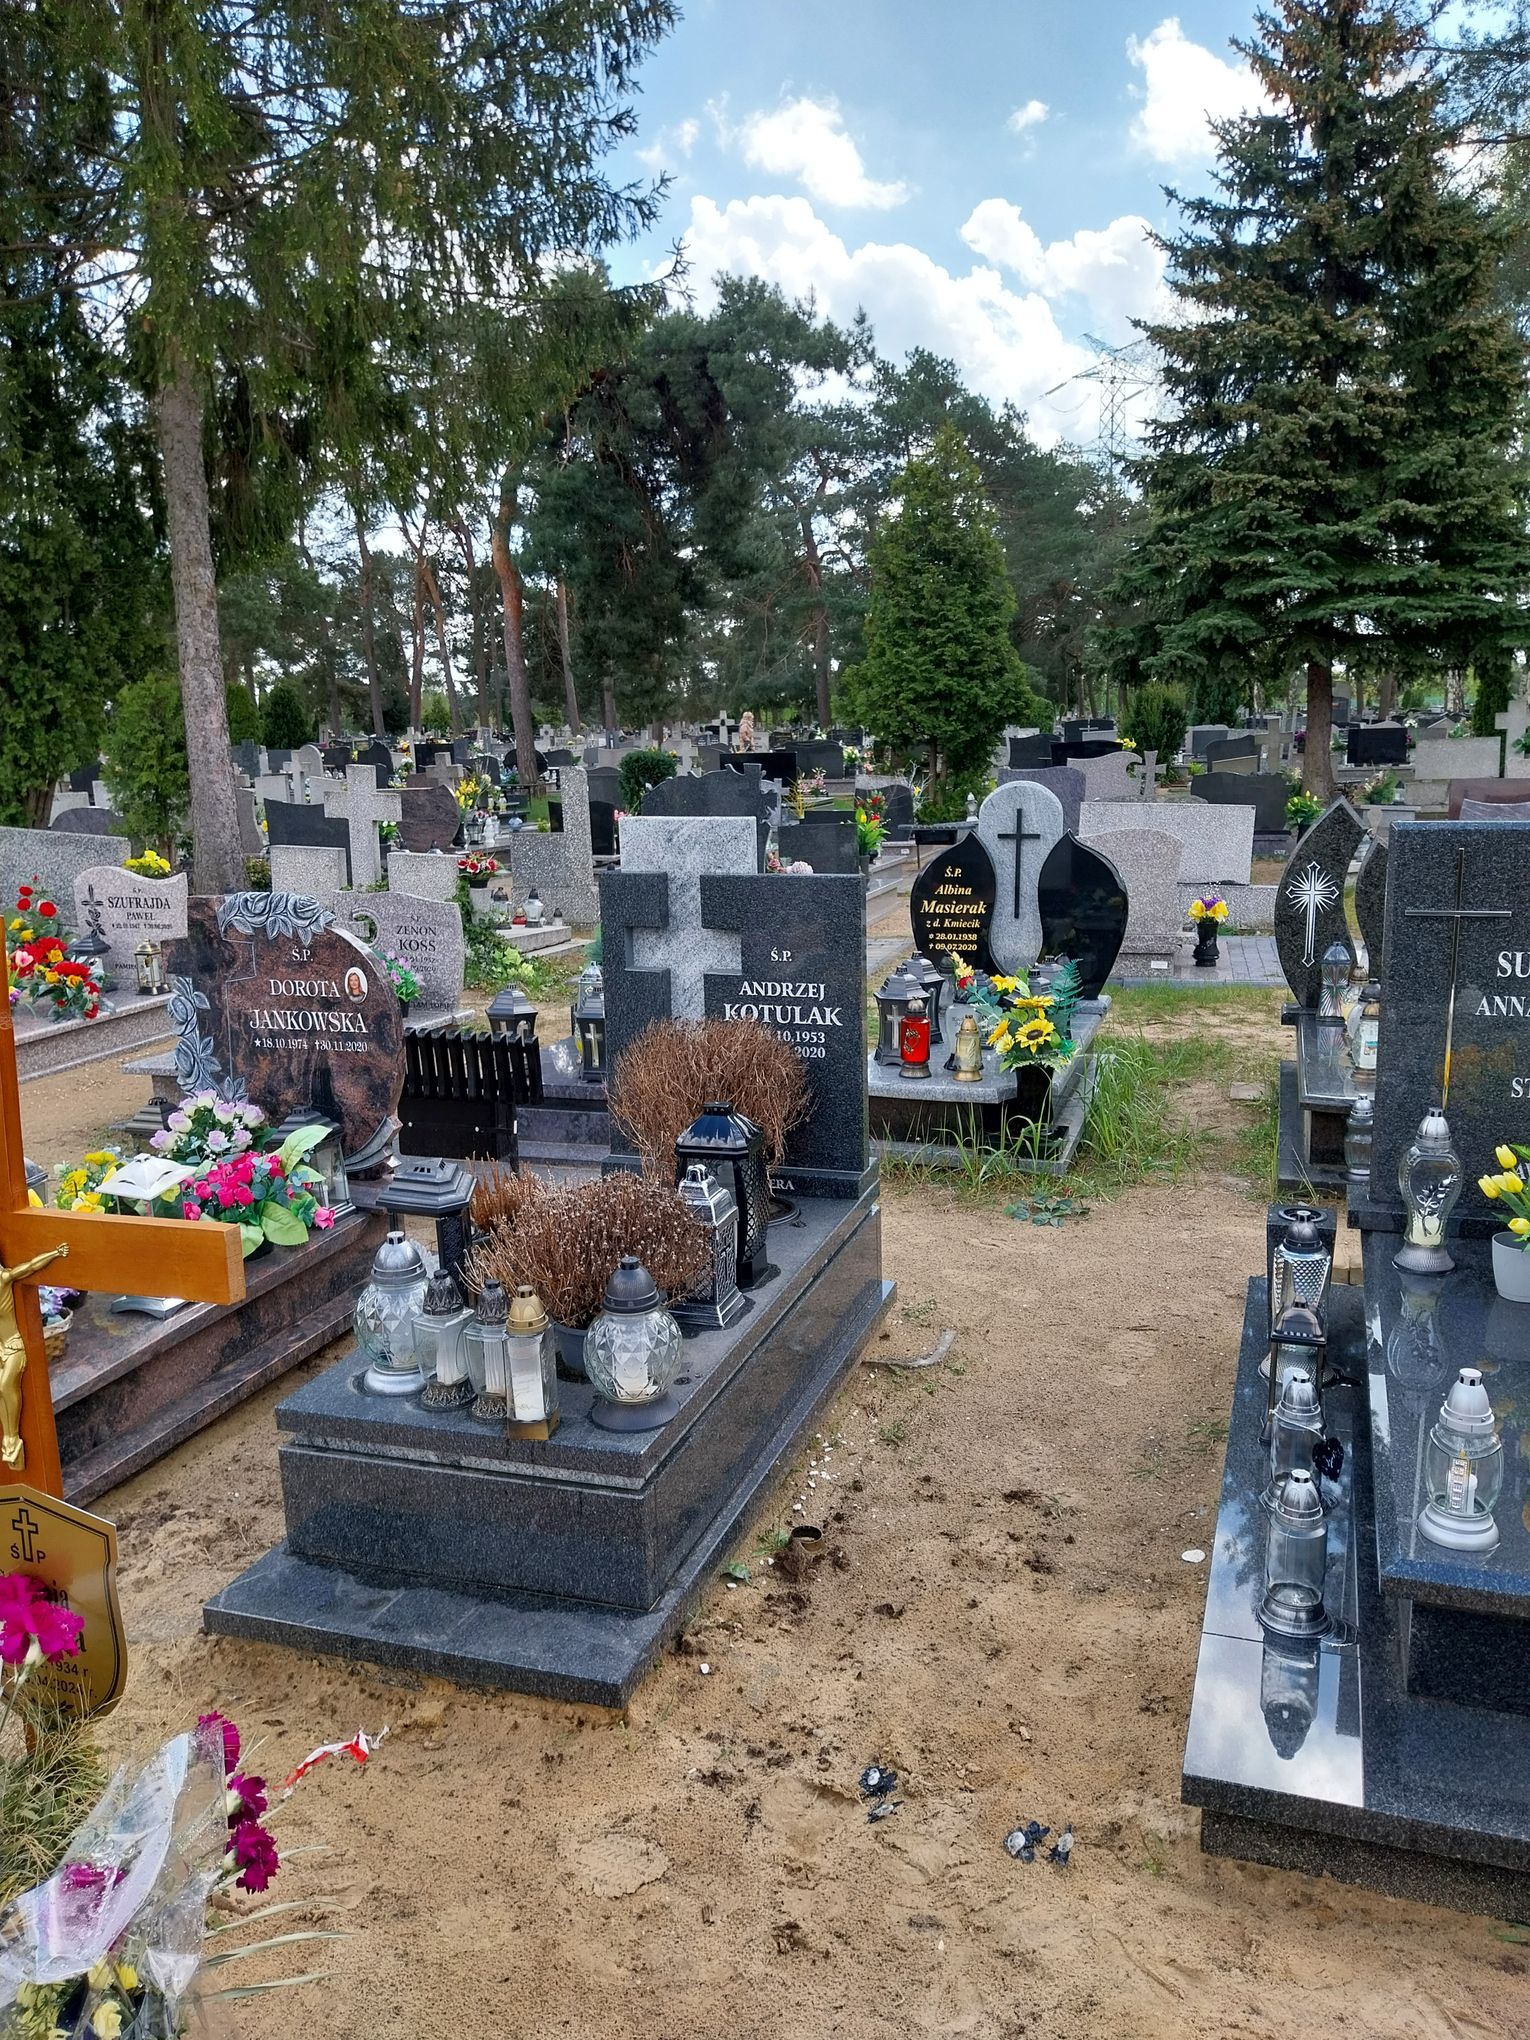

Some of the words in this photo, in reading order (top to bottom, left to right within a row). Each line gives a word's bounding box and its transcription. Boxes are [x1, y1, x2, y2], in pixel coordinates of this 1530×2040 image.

[944, 865, 962, 878] Ś.P.
[934, 884, 972, 896] Albina
[107, 896, 171, 910] SZUFRAJDA
[920, 900, 987, 914] Masierak
[926, 920, 931, 928] z
[933, 918, 941, 928] d.
[943, 918, 981, 929] Kmiecik
[396, 925, 437, 937] ZENON
[935, 933, 978, 941] 28.01.1938
[291, 945, 314, 961] Ś.P.
[399, 940, 437, 952] KOSS
[935, 943, 978, 951] 09.07.2020
[770, 947, 792, 962] Ś.P.
[269, 979, 341, 998] DOROTA
[739, 981, 826, 1002] ANDRZEJ
[249, 1008, 369, 1033] JANKOWSKA
[723, 1003, 843, 1026] KOTULAK
[262, 1038, 308, 1050] 18.10.1974
[320, 1041, 368, 1052] 30.11.2020
[10, 1543, 20, 1560] Ś
[36, 1551, 46, 1564] P
